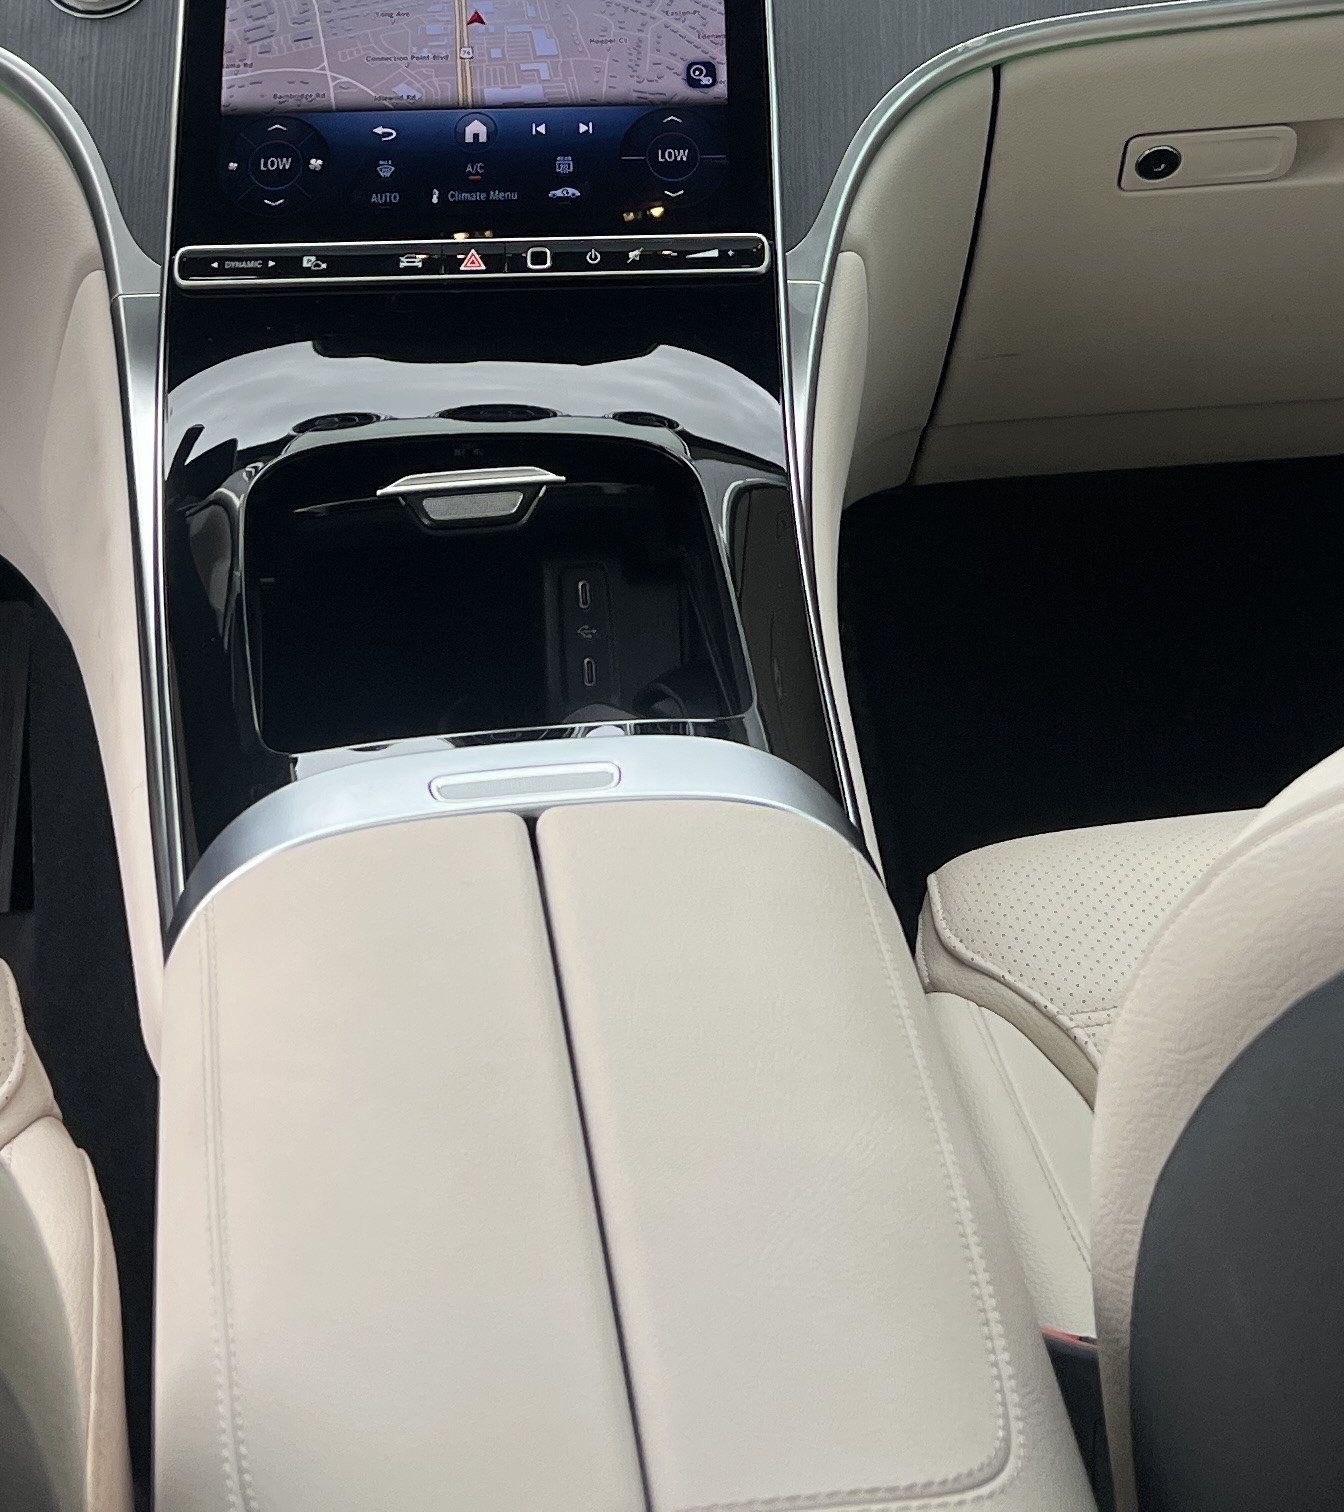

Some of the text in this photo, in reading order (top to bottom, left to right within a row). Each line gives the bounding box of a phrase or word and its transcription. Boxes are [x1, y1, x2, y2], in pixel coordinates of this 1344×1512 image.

[657, 148, 689, 162] LOW
[259, 156, 292, 171] LOW
[465, 162, 485, 174] A/C
[370, 192, 400, 204] AUTO
[447, 189, 518, 202] Climate Menu
[224, 260, 263, 269] DYNAMIC
